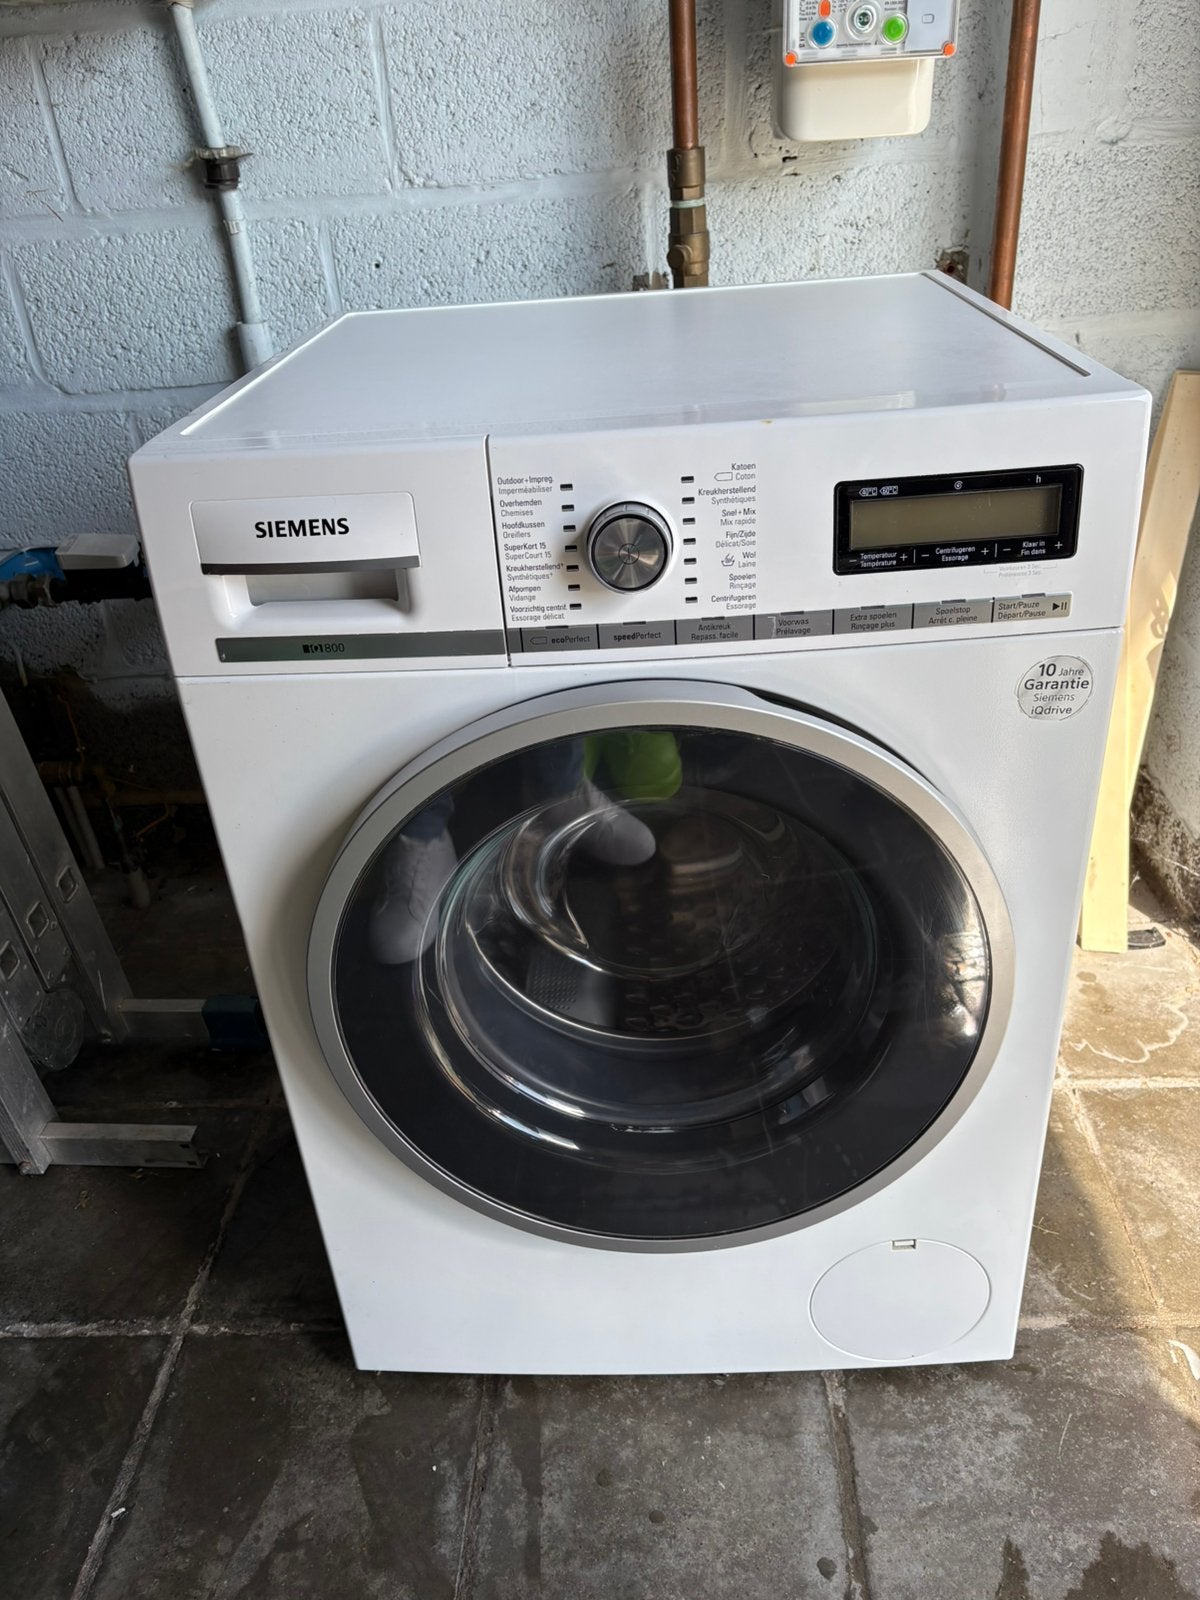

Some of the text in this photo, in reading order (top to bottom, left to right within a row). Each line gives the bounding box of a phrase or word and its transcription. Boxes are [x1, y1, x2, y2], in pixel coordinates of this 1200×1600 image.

[1035, 474, 1041, 484] h
[499, 486, 552, 495] Imperméabiliser
[698, 485, 756, 496] Kreukherstellend
[500, 499, 542, 508] Overhemden
[712, 496, 756, 506] Synthétiques
[735, 517, 756, 526] rapide
[254, 518, 350, 539] SIEMENS
[726, 531, 756, 539] Fijn/Zijde
[504, 543, 538, 552] SuperKort
[935, 546, 975, 554] Centrifugeren
[505, 552, 542, 561] SuperCourt
[729, 573, 756, 582] Spoelen
[729, 582, 756, 590] Rinçage
[711, 594, 756, 602] Centrifugeren
[510, 604, 545, 613] Voorzichtig
[726, 602, 756, 610] Essorage
[999, 601, 1040, 610] Start/Pauze
[936, 606, 970, 616] Spoelstop
[998, 610, 1046, 620] Départ/Pause
[870, 612, 897, 620] spoelen
[956, 614, 978, 623] pleine
[778, 618, 809, 626] Voorwas
[851, 621, 895, 631] Rinçage plus
[776, 627, 811, 635] Prélavage
[551, 636, 590, 644] ecoPerfect
[613, 631, 662, 641] speedPerfect
[1039, 663, 1084, 677] 10 Jahre
[1024, 677, 1089, 690] Garantie
[1033, 693, 1075, 702] Siemens
[1031, 706, 1072, 715] iQdrive
